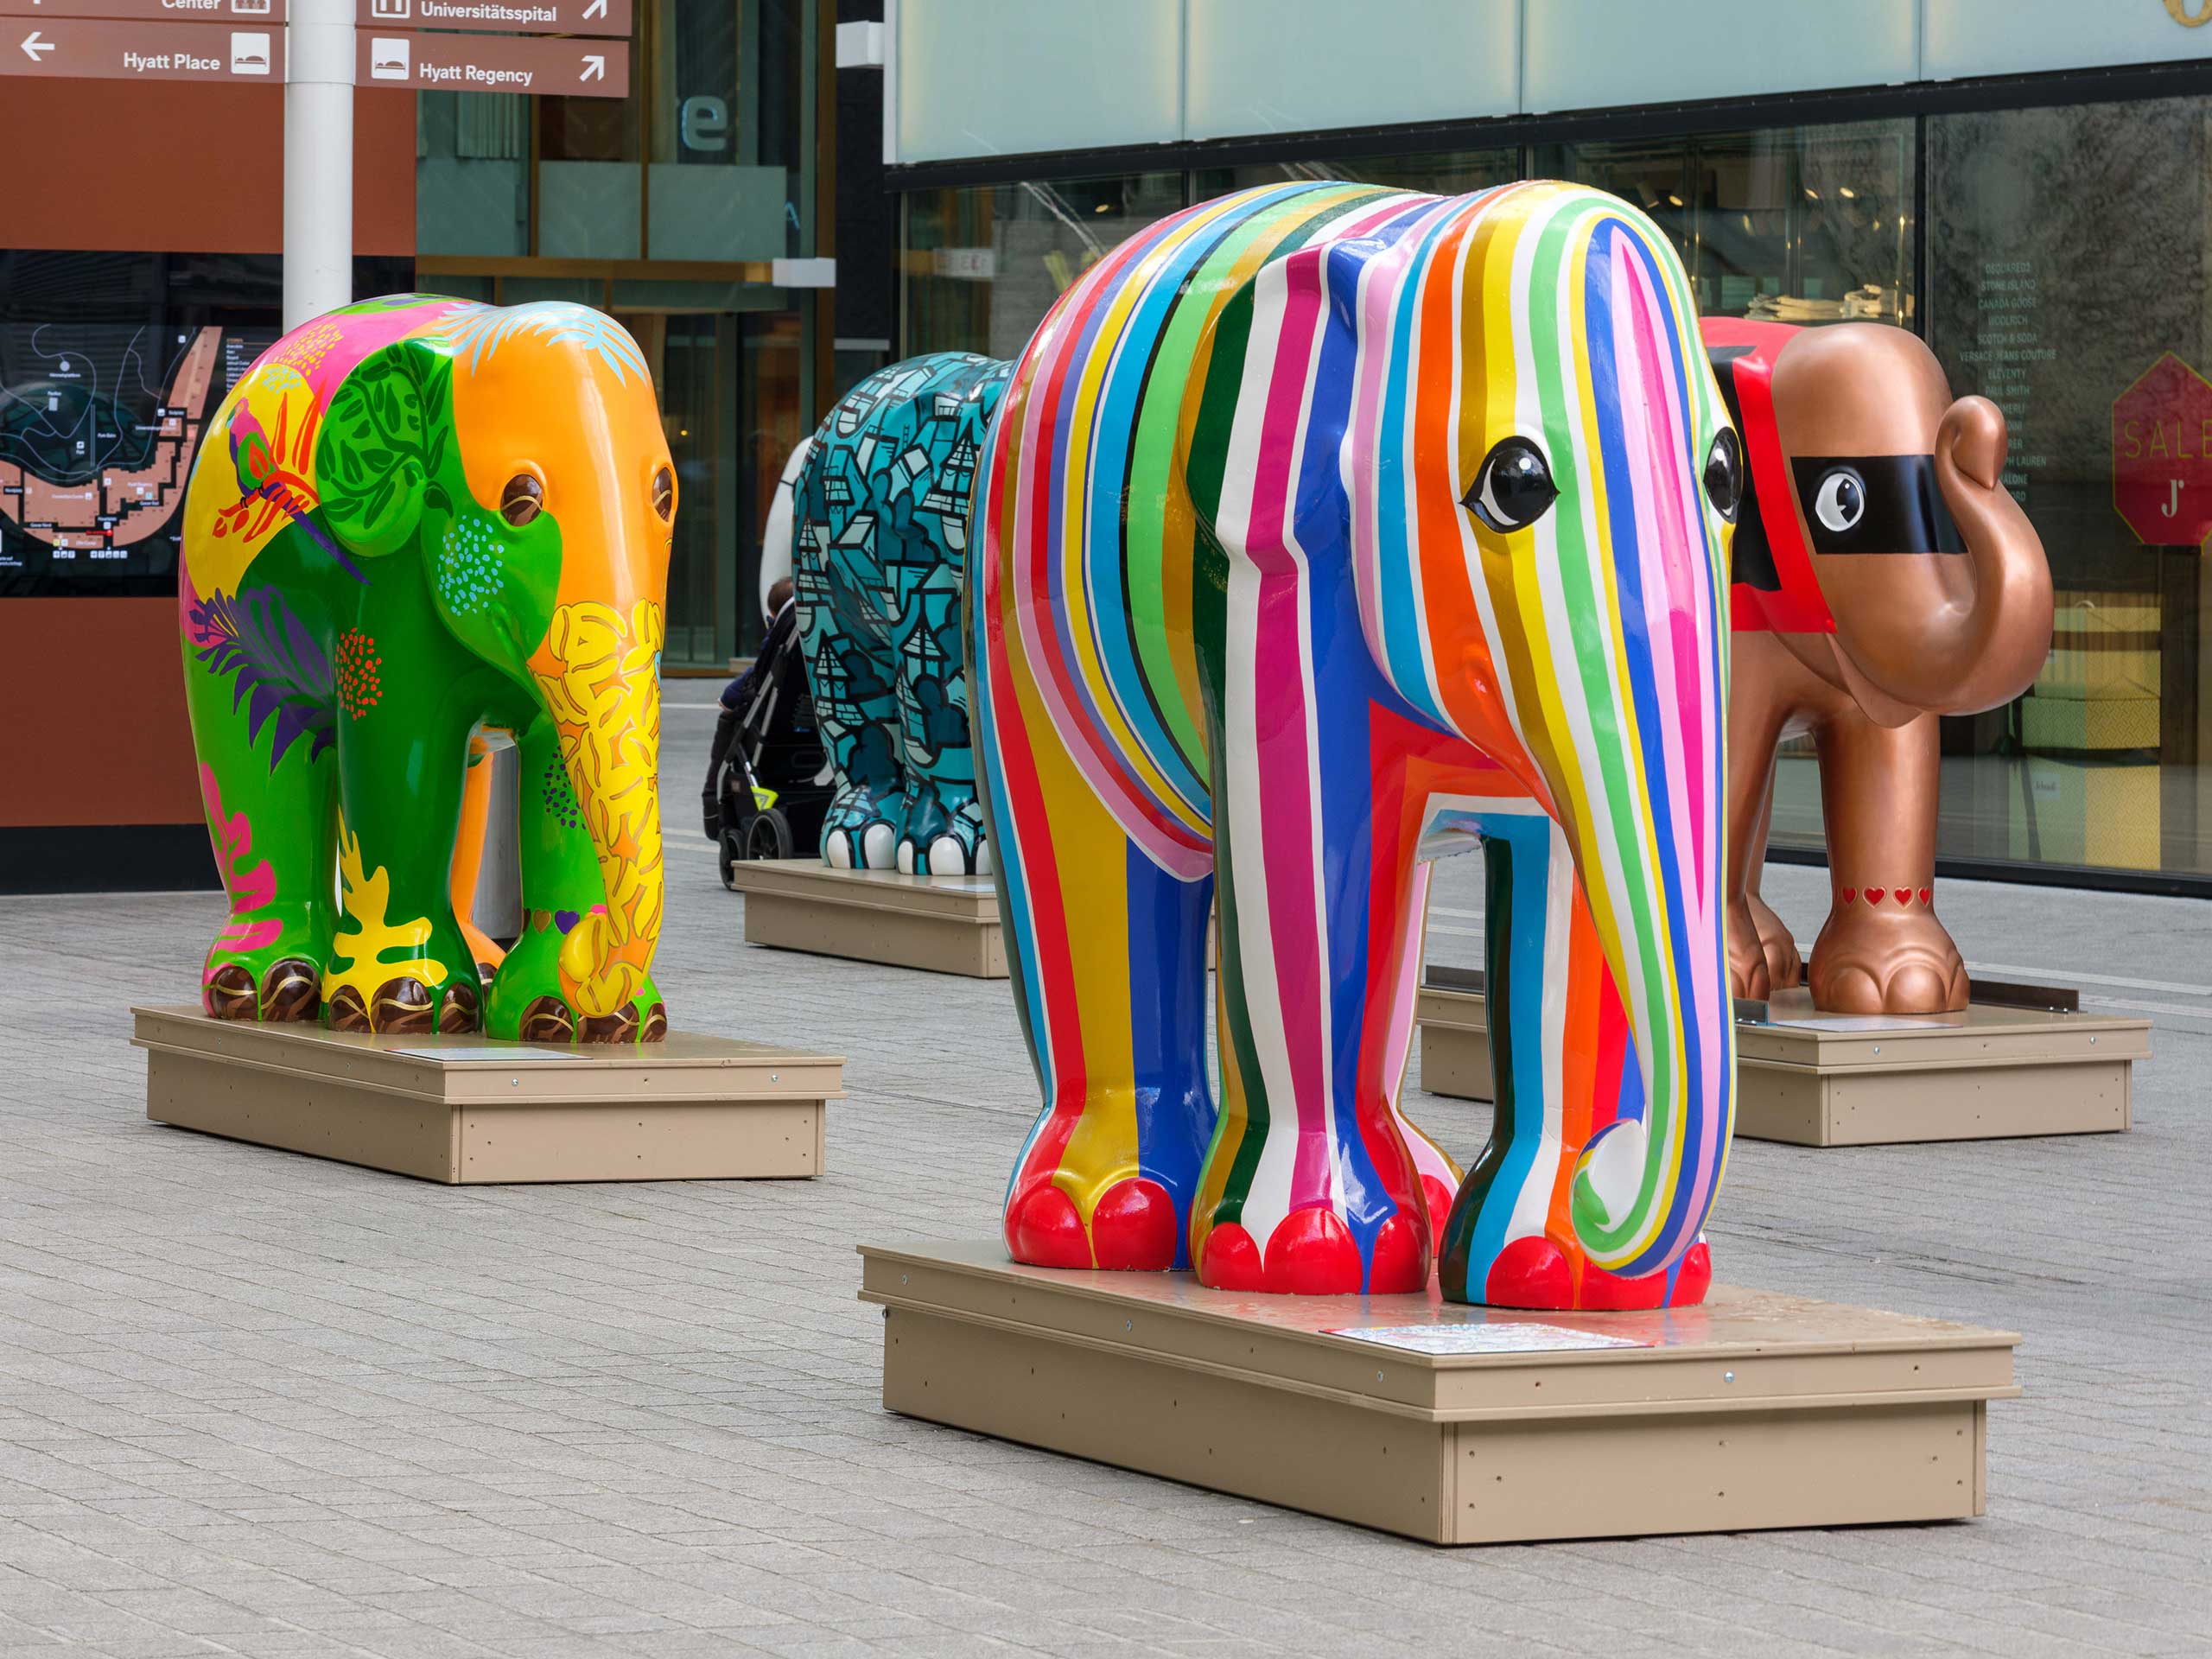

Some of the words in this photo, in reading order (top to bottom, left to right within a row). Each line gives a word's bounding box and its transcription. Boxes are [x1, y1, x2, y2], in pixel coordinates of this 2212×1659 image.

[421, 1, 556, 24] Universitätsspital
[124, 52, 170, 73] Hyatt
[174, 54, 221, 71] Place
[420, 63, 461, 83] Hyatt
[465, 65, 532, 86] Regency
[1980, 281, 2005, 291] STONE
[2007, 279, 2036, 290] ISLAND
[1978, 298, 2009, 309] CANADA
[2011, 296, 2037, 308] GOOSE
[1978, 333, 2006, 345] SCOTCH
[2017, 333, 2037, 344] SODA
[1959, 350, 1993, 361] VERSACE
[1993, 350, 2019, 360] JEANS
[2020, 348, 2056, 360] COUTURE
[1988, 369, 2026, 380] ELEVENTY
[1985, 386, 2004, 396] PAUL
[2005, 385, 2031, 396] SMITH
[2016, 454, 2047, 467] LAUREN
